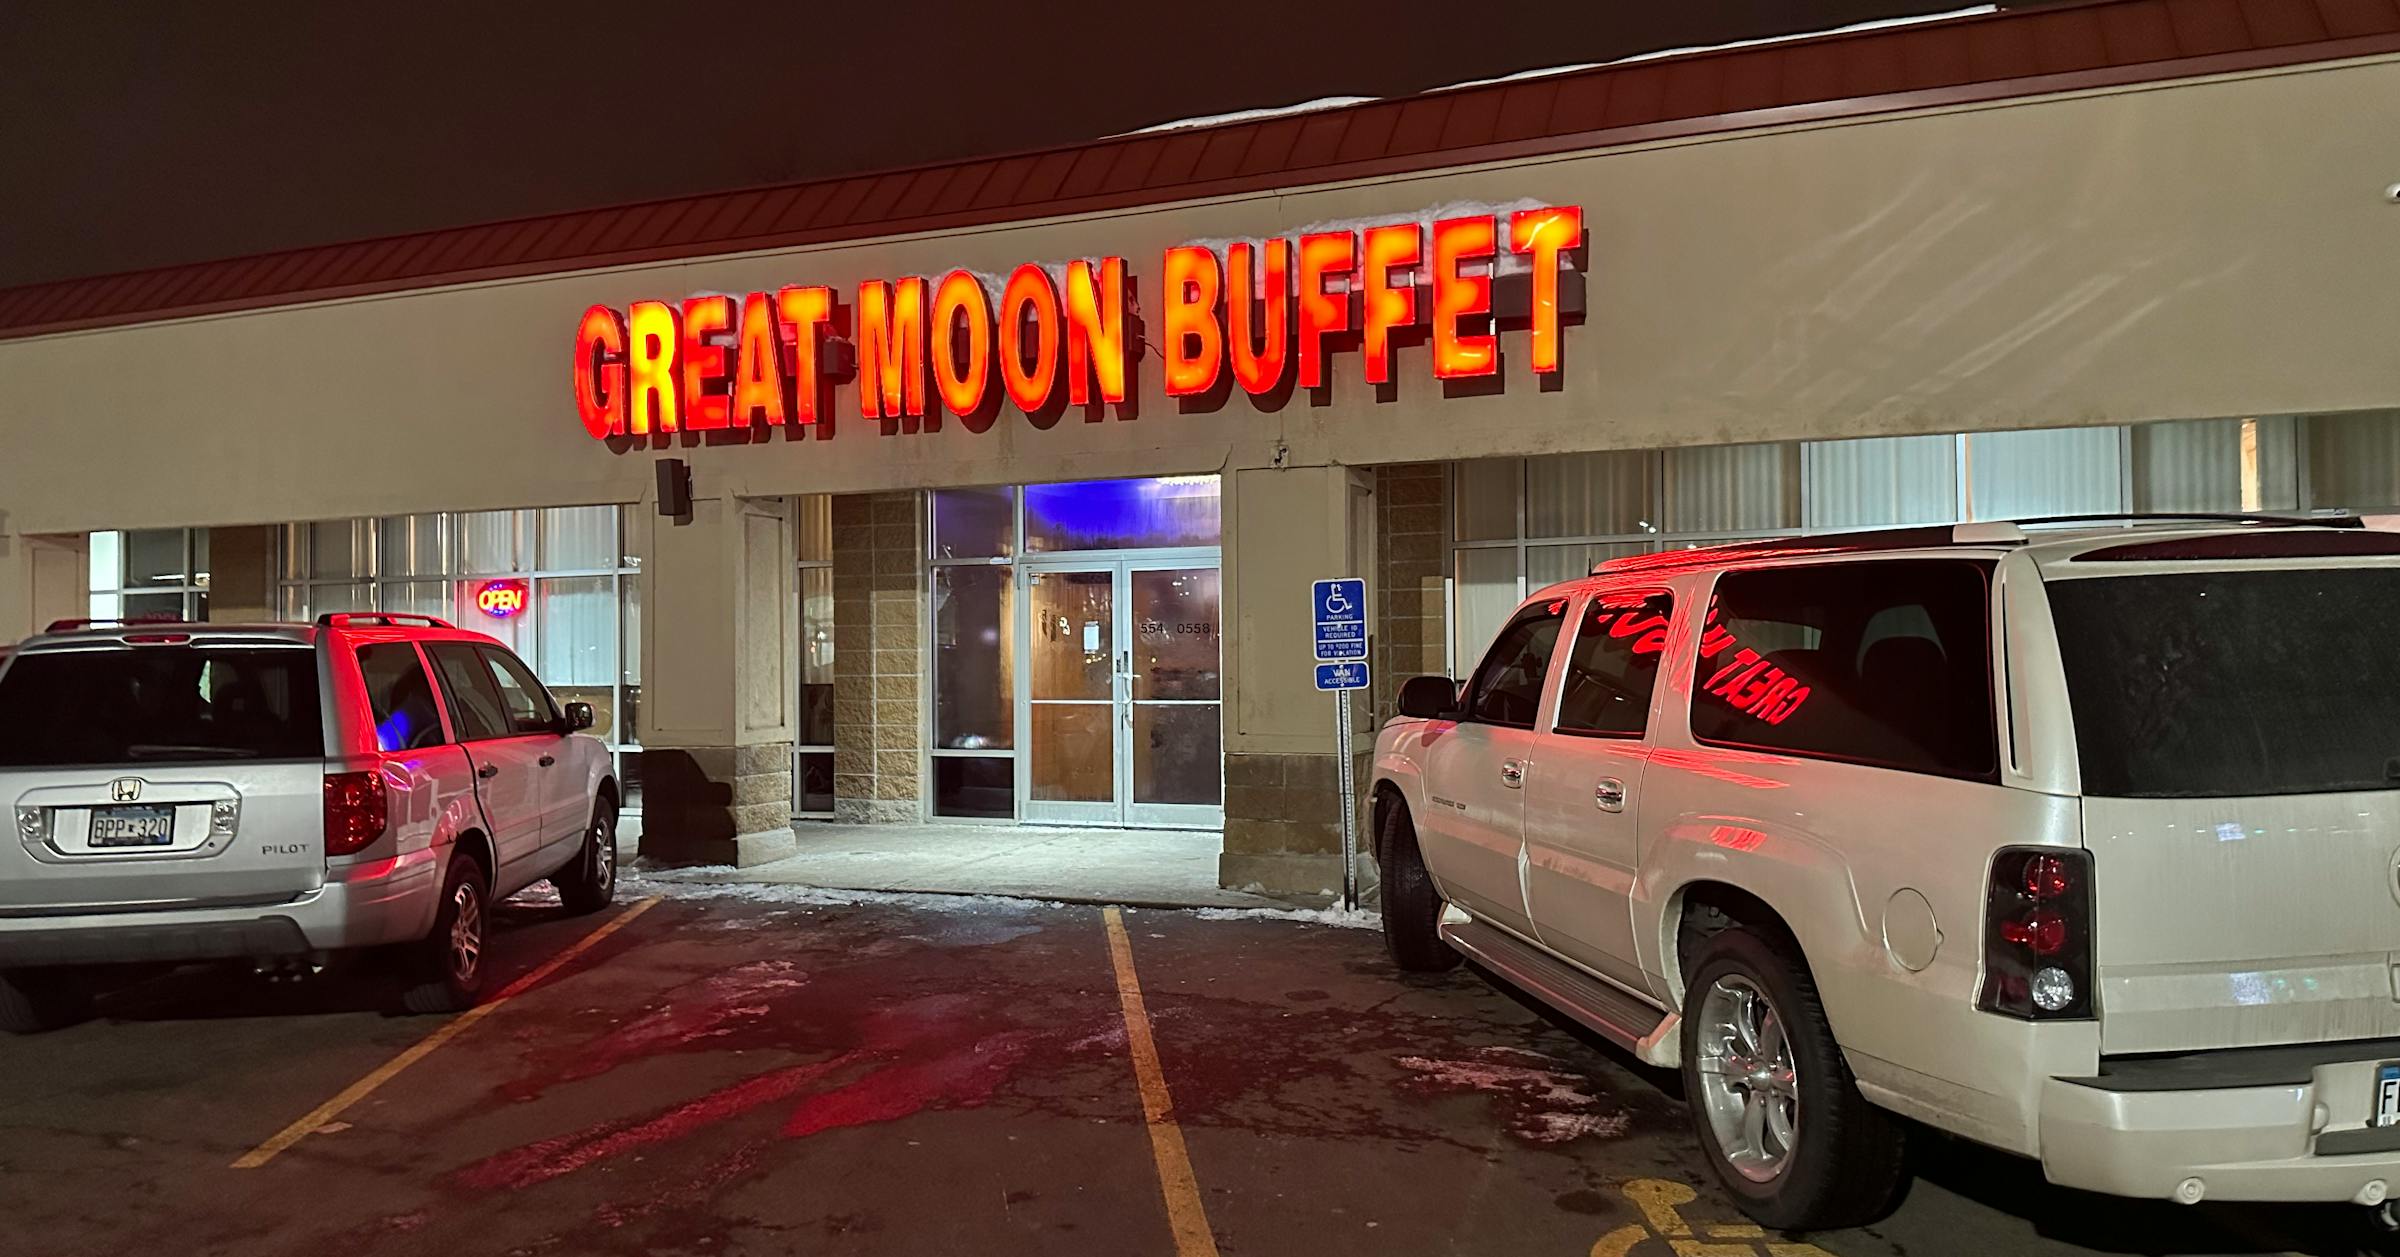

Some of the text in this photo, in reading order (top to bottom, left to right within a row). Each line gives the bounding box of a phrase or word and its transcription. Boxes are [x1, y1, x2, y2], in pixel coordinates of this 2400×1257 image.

[575, 205, 1583, 440] GREAT MOON BUFFET
[479, 589, 522, 610] OPEN
[1141, 622, 1210, 634] 554 0558
[1332, 668, 1351, 677] VAN
[1324, 676, 1360, 684] ACCESSIBLE
[261, 844, 310, 855] PILOT
